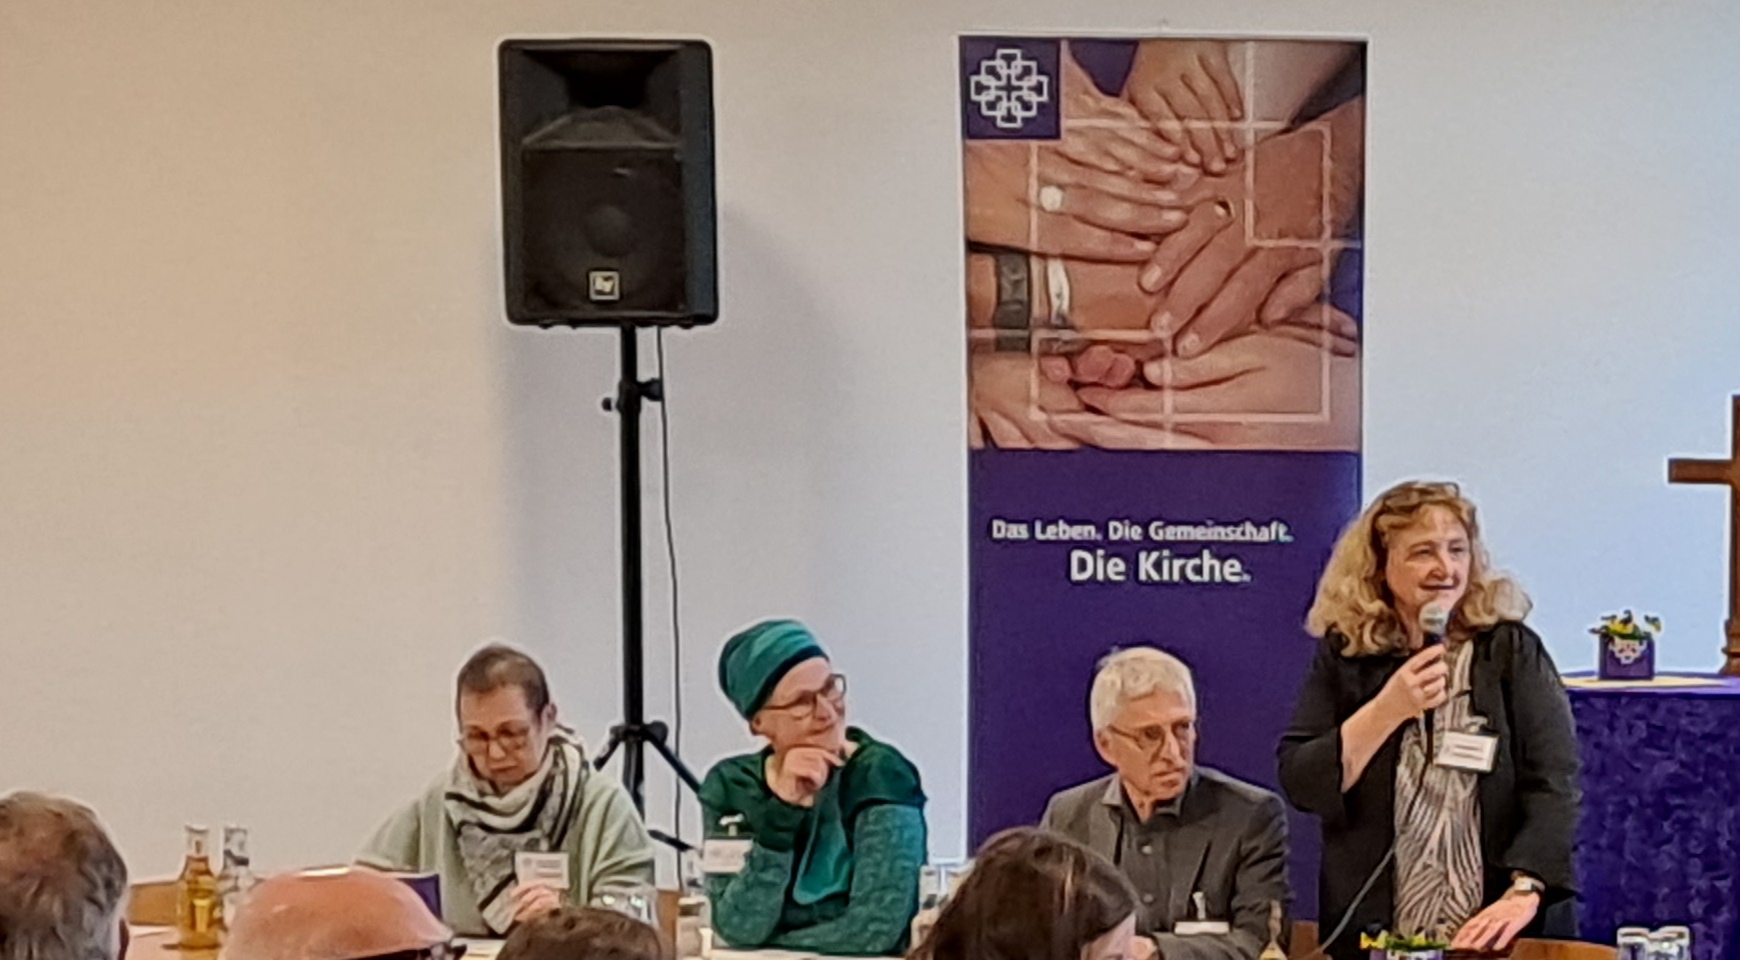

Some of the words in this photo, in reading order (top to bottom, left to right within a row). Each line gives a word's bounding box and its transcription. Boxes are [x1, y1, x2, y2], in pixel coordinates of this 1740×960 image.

[992, 519, 1029, 540] Das
[1034, 519, 1102, 541] Leben.
[1108, 519, 1143, 541] Die
[1148, 519, 1294, 543] Gemeinschaft.
[1070, 549, 1126, 581] Die
[1138, 549, 1252, 583] Kirche.
